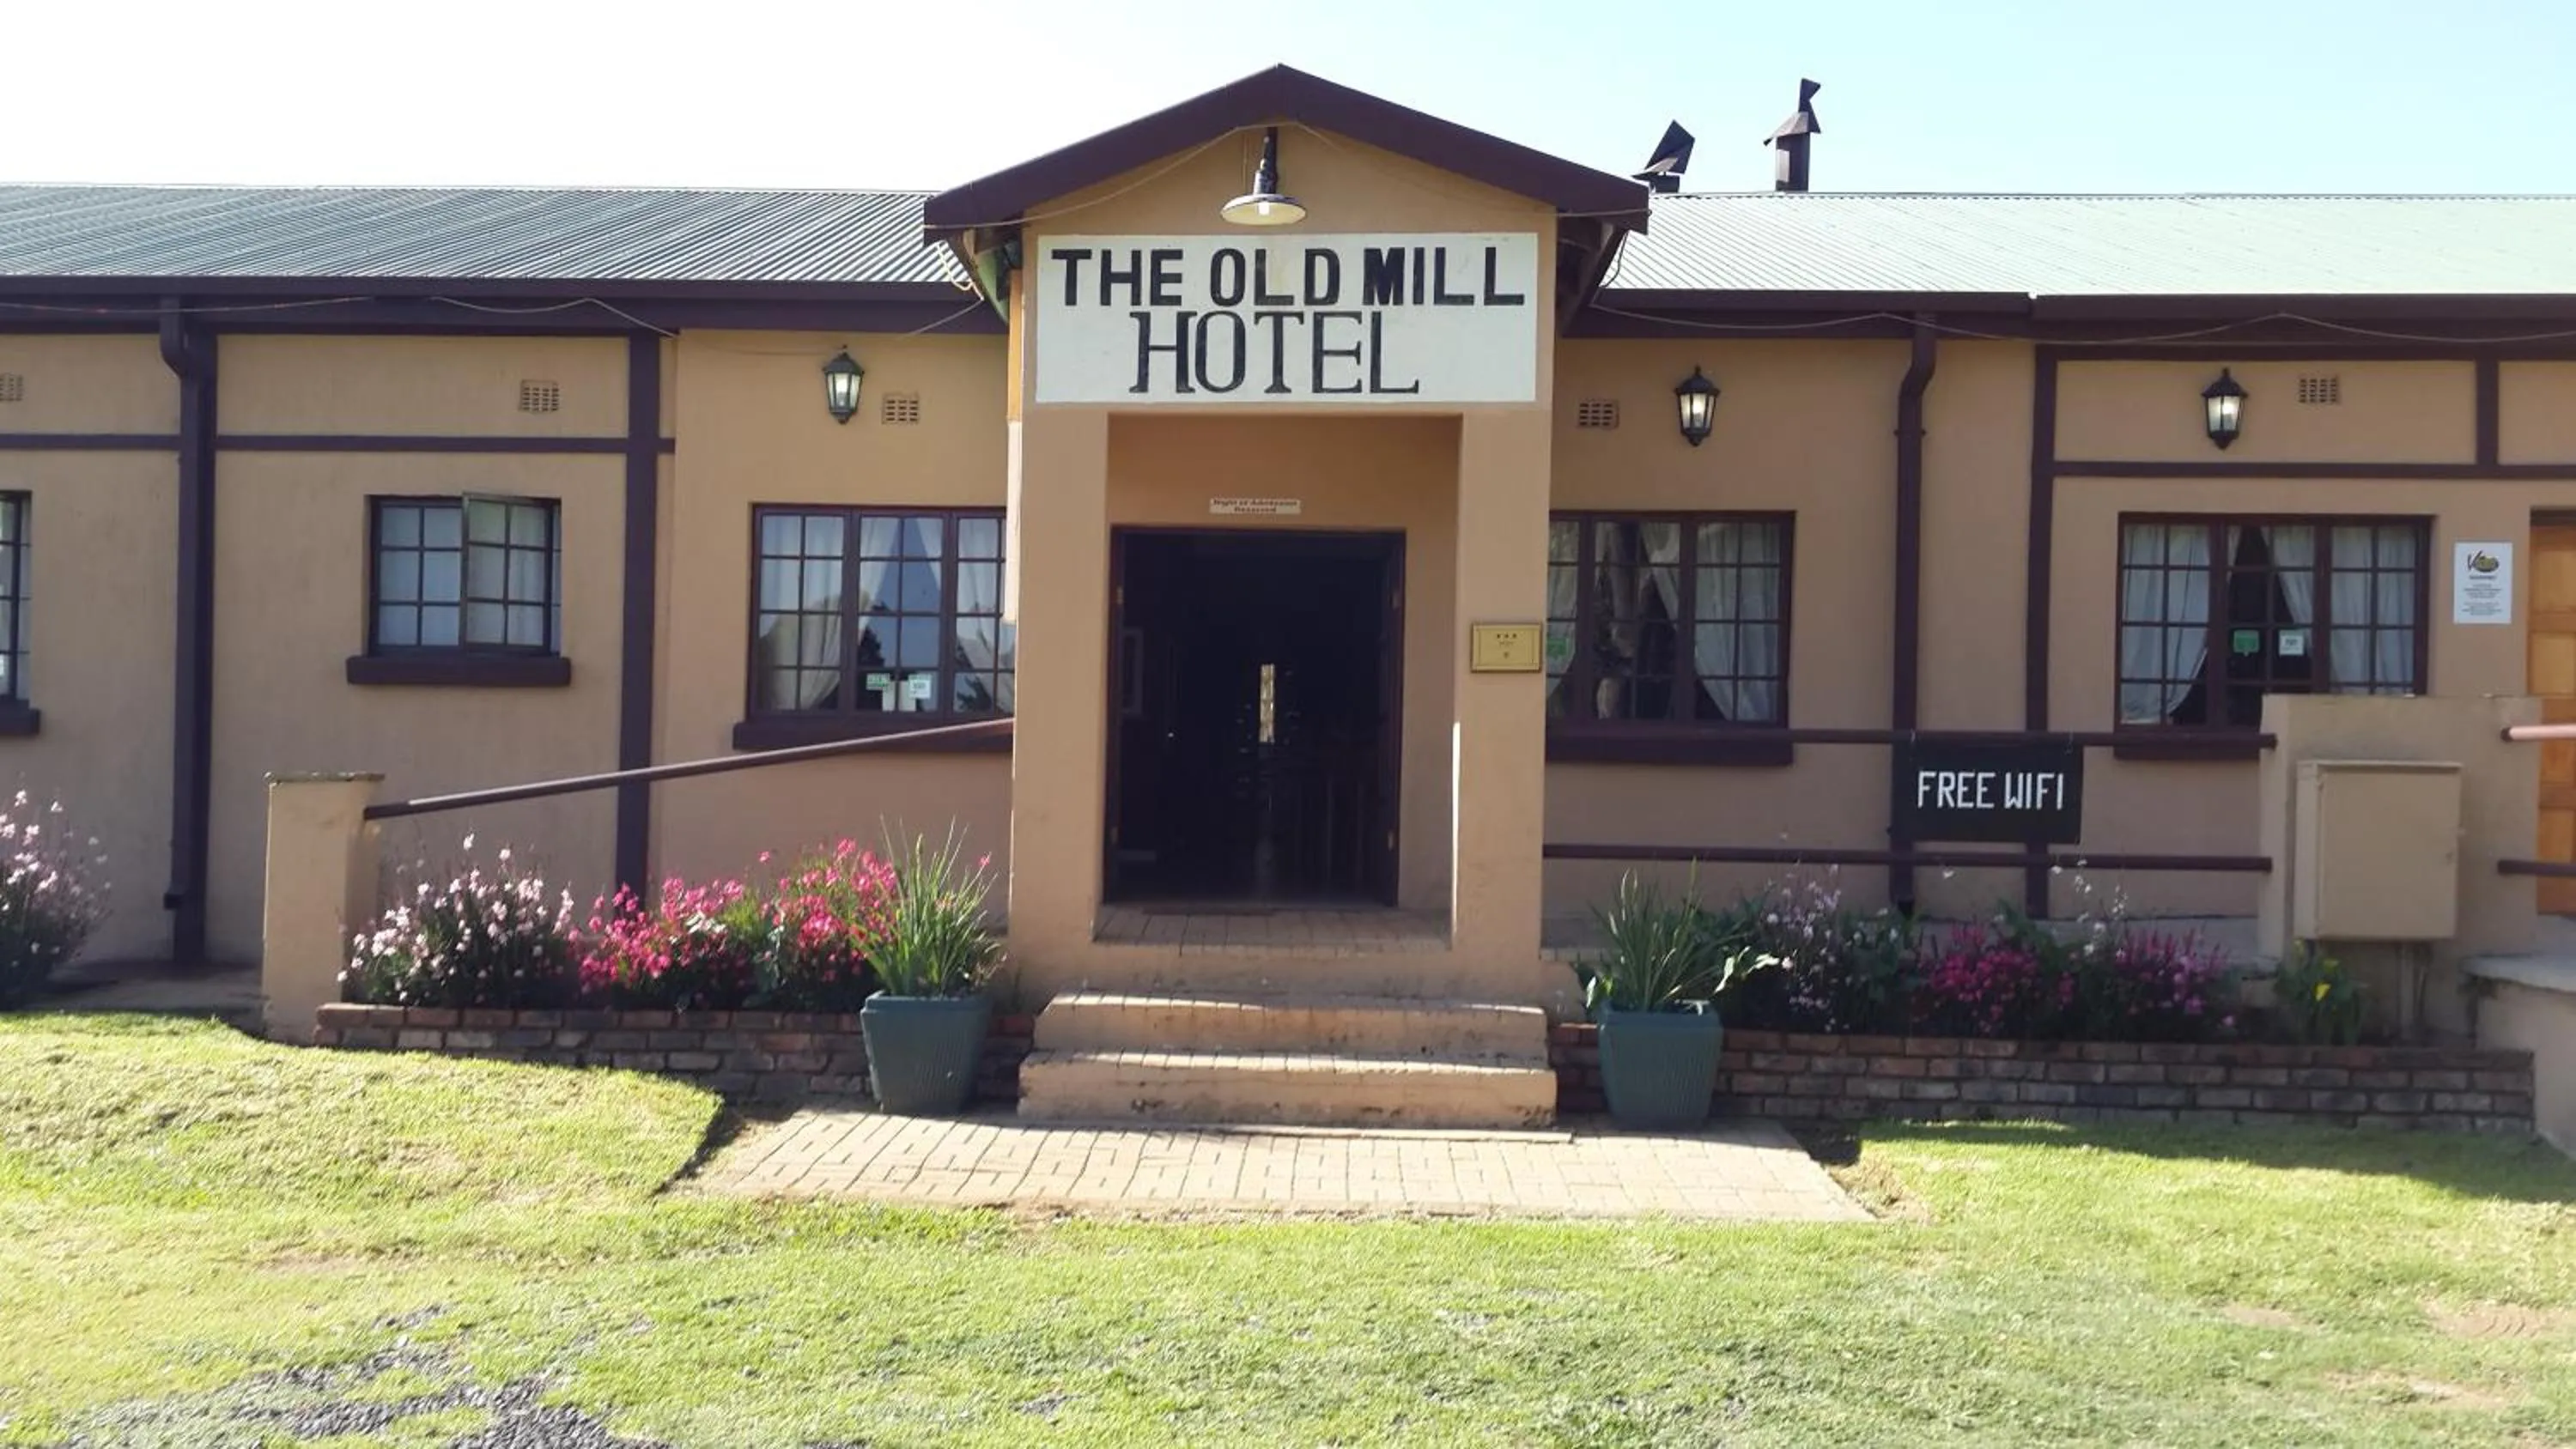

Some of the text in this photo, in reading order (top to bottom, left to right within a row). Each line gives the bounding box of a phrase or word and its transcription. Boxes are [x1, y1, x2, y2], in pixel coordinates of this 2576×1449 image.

[1051, 246, 1526, 306] THE OLD MILL
[1128, 310, 1420, 395] HOTEL
[1917, 771, 2064, 810] FREE WIFI
